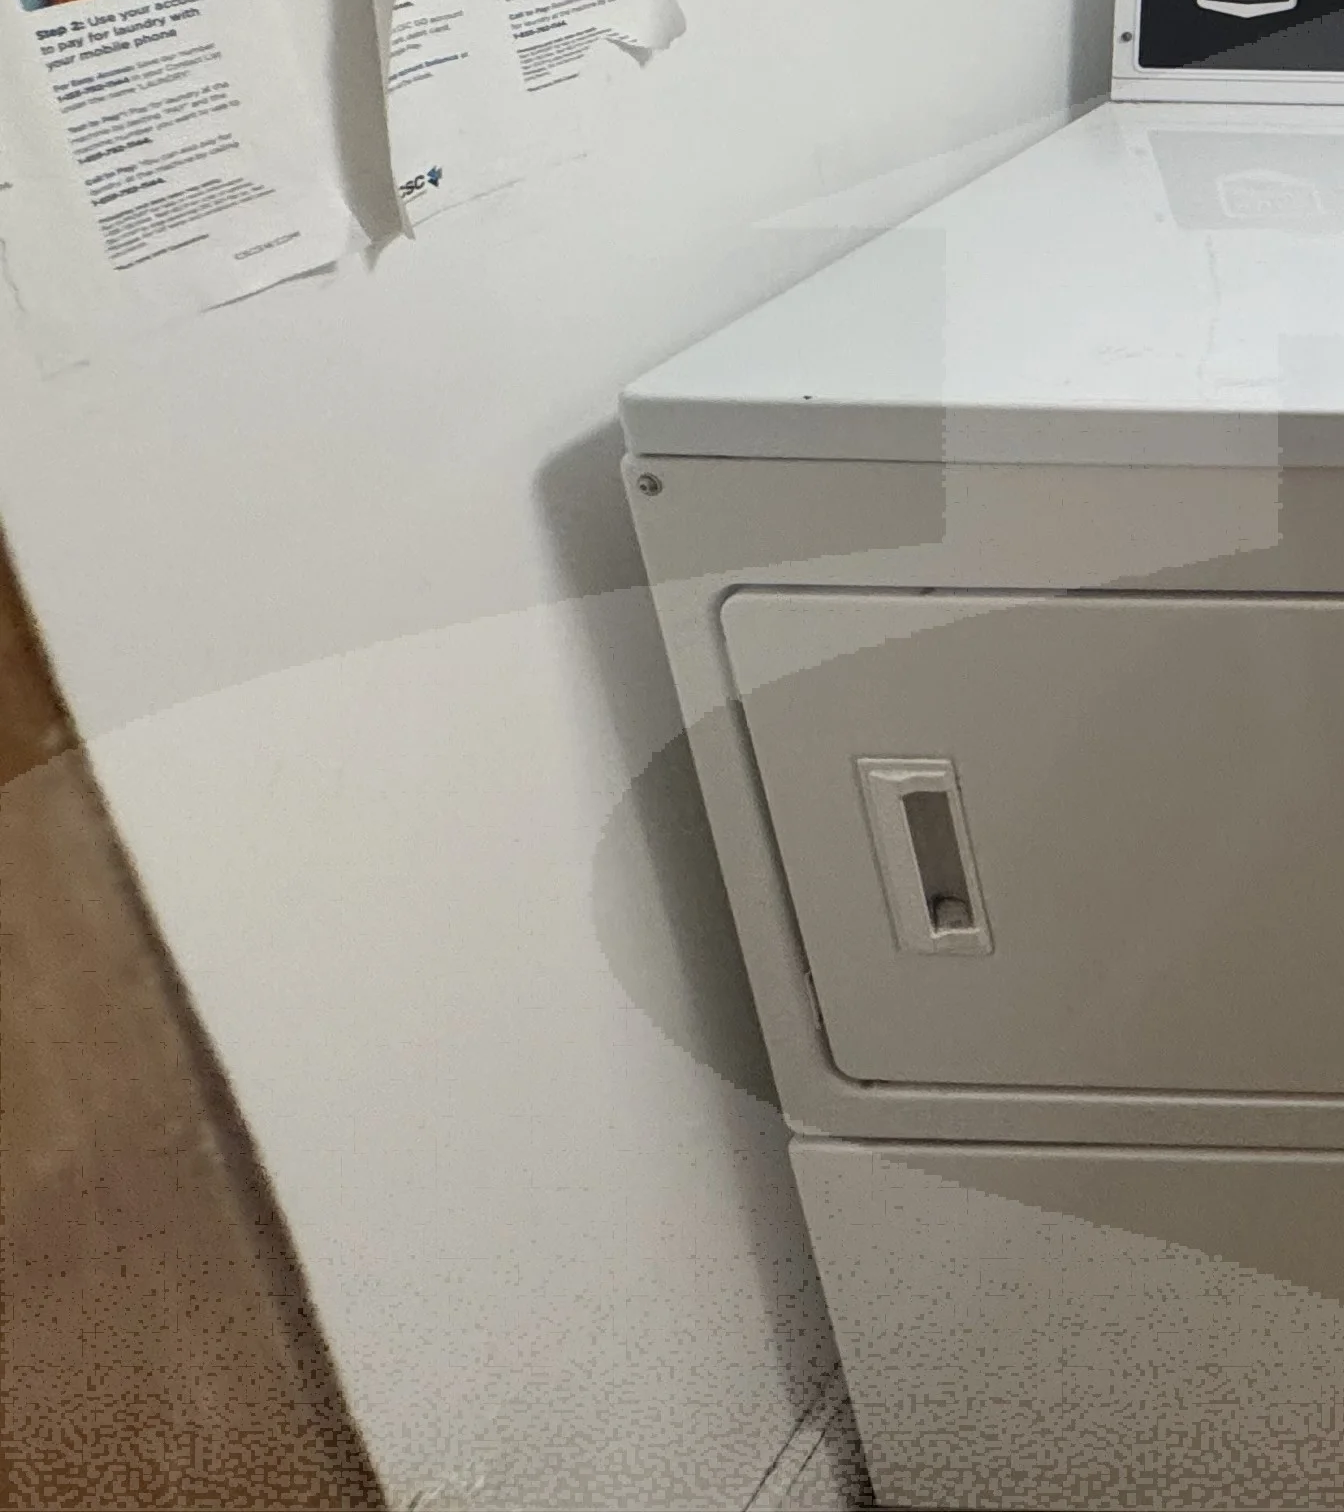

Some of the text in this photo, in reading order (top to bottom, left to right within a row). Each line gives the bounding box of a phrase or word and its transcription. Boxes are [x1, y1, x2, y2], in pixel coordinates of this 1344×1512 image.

[36, 26, 67, 40] Step
[70, 21, 85, 31] 2:
[87, 13, 116, 27] Use
[120, 5, 150, 21] your
[39, 8, 200, 55] to pay for laundry with
[46, 29, 177, 72] your mobile phone
